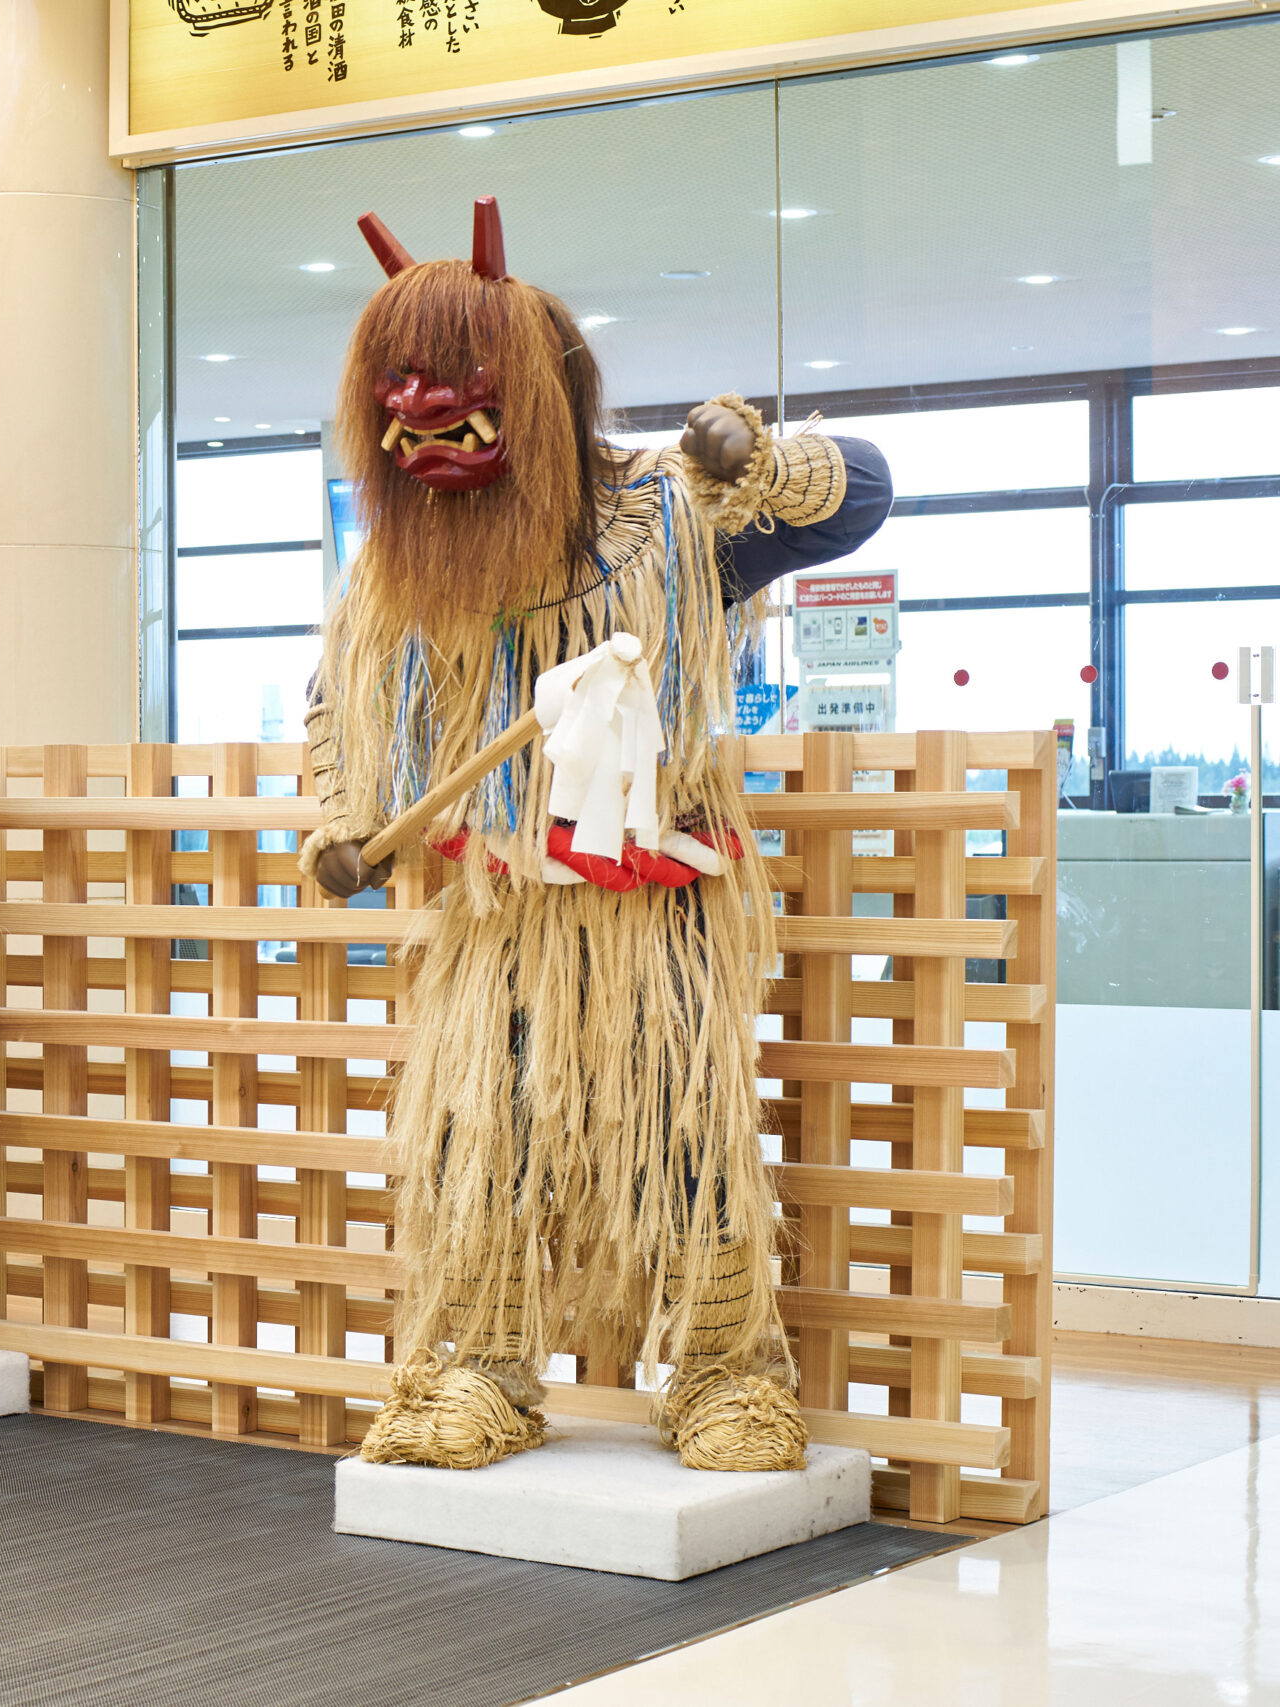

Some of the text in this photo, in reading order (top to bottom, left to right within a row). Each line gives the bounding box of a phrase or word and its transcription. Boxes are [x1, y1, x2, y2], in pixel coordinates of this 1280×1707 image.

[327, 0, 348, 82] 田の清酒
[445, 0, 460, 54] とした
[818, 702, 876, 715] 出発準備中
